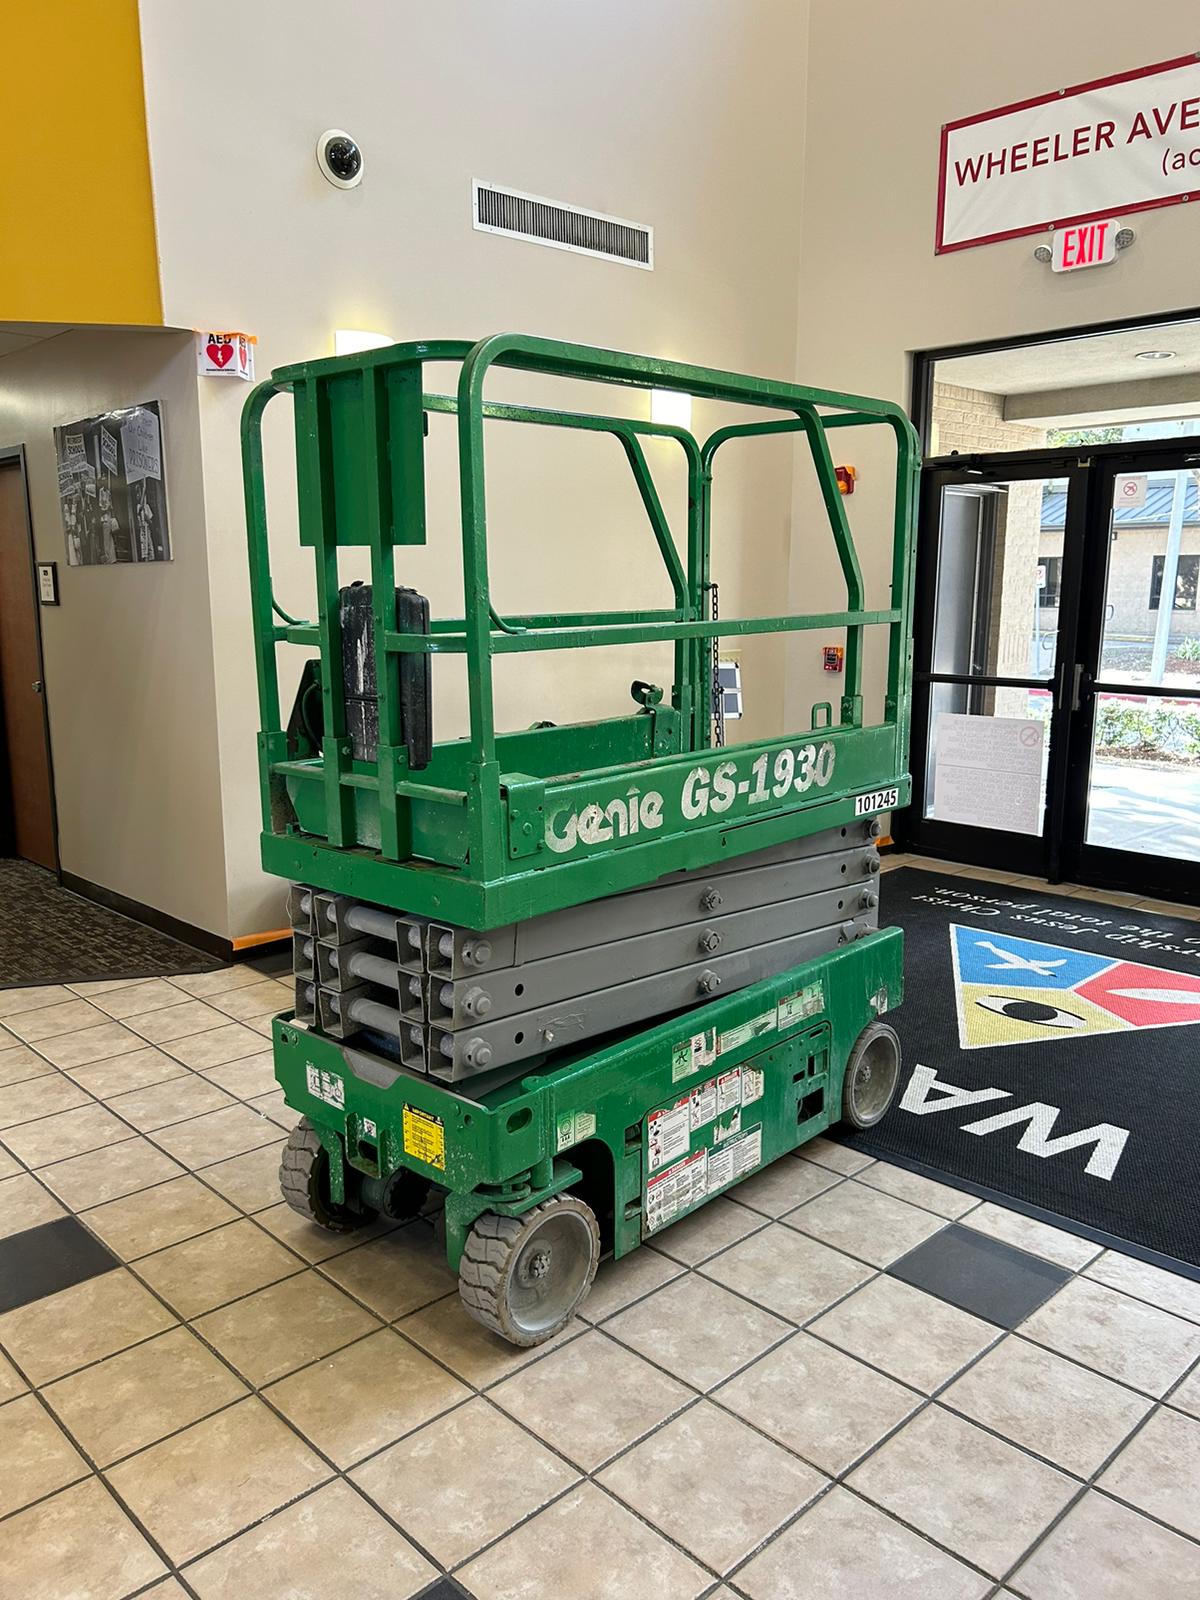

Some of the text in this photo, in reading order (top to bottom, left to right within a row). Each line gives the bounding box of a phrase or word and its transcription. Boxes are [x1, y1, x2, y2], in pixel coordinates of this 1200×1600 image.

[954, 120, 1116, 187] WHEELER
[1062, 223, 1109, 268] EXIT
[208, 333, 232, 344] AED
[545, 741, 836, 853] Genie GS-1930
[857, 790, 897, 814] 101245
[911, 895, 1001, 916] Christ
[934, 887, 1041, 910] person.
[1009, 914, 1100, 934] Jesus
[1032, 909, 1113, 926] total
[1119, 924, 1174, 938] the
